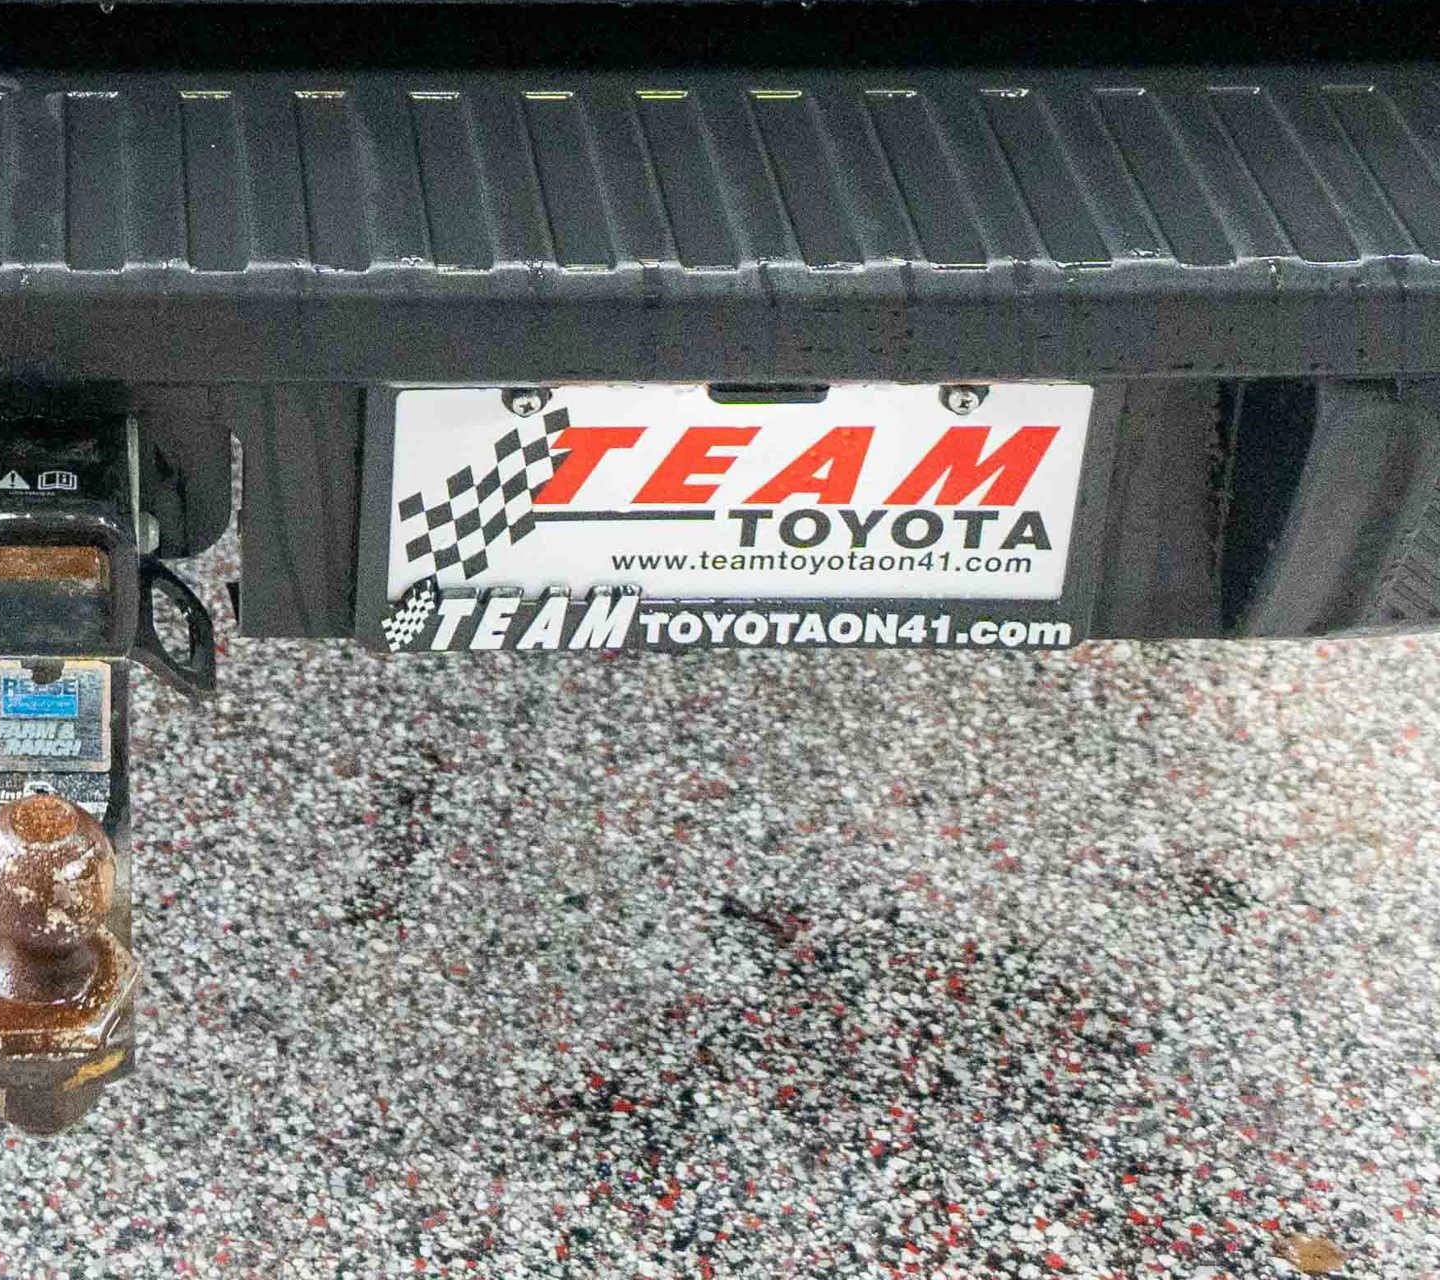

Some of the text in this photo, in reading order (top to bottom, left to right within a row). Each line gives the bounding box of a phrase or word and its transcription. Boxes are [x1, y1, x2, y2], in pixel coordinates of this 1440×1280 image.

[532, 425, 1060, 507] TEAM
[728, 508, 1053, 552] TOYOTA
[611, 549, 1033, 576] www.teamtoyotaon41.com
[430, 594, 1072, 651] TEAM TOYOTAON41.com
